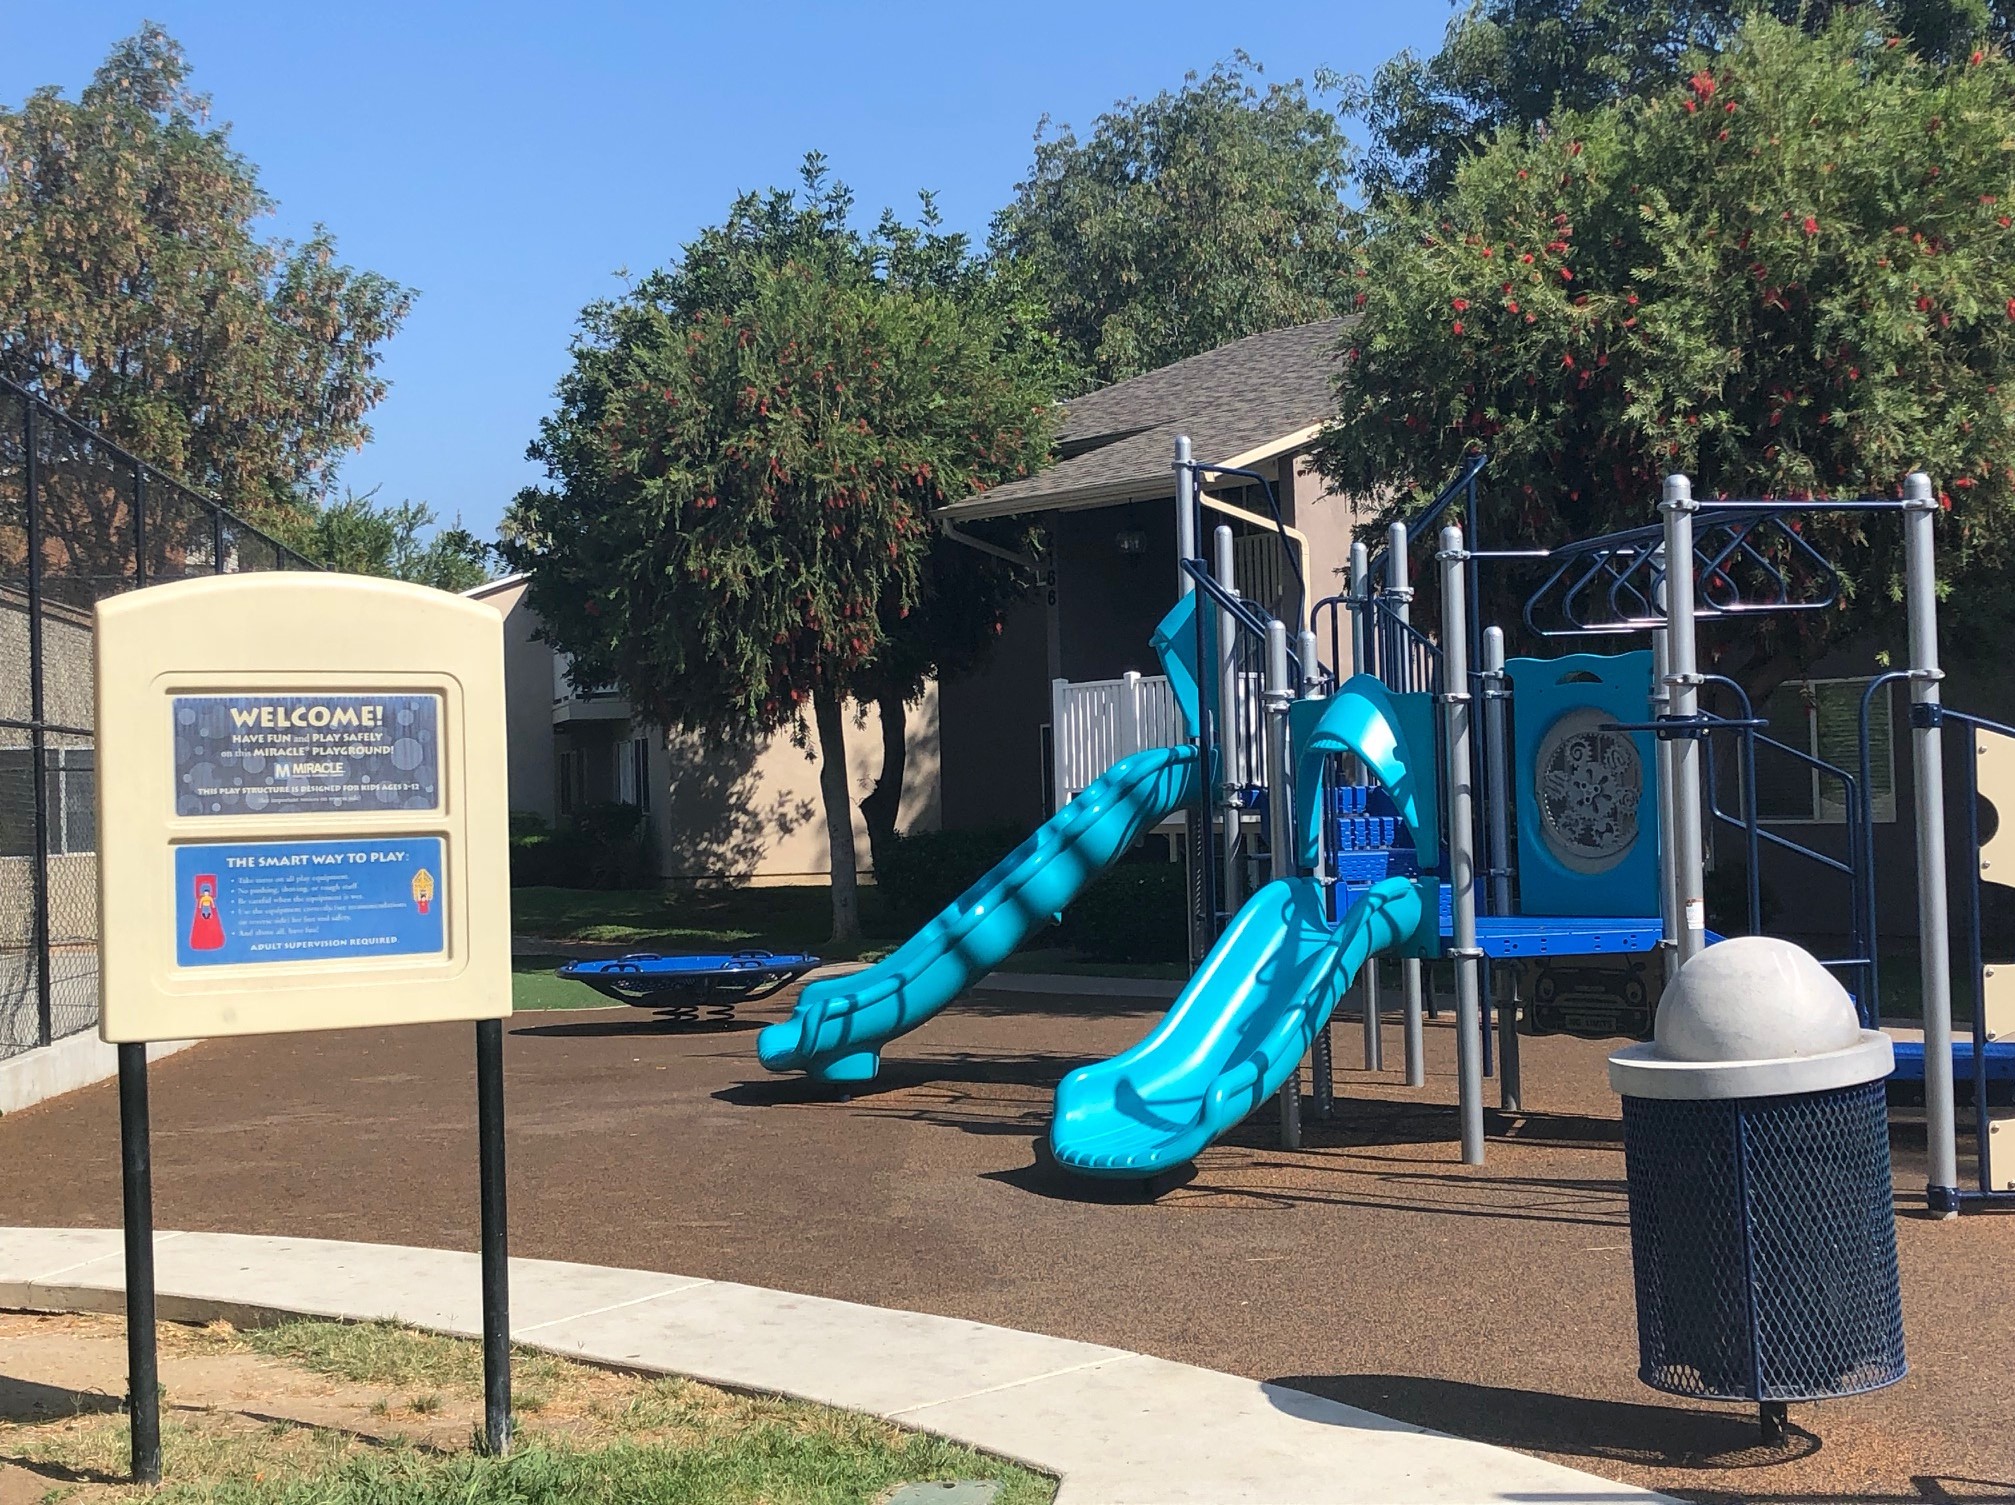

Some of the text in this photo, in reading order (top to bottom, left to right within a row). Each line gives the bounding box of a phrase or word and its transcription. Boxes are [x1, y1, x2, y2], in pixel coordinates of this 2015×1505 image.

[230, 706, 383, 728] WELCOME!
[233, 733, 382, 743] HAVE FUN and PLAY SAFELY
[221, 750, 233, 758] on
[235, 749, 251, 758] this
[313, 747, 394, 755] PLAYGROUND!
[293, 763, 343, 773] MIRACLE
[242, 786, 289, 794] STRUCTURE
[227, 852, 409, 868] THE SMART WAY TO PLAY:
[251, 943, 282, 951] ADULT
[284, 939, 347, 949] SUPERVISION
